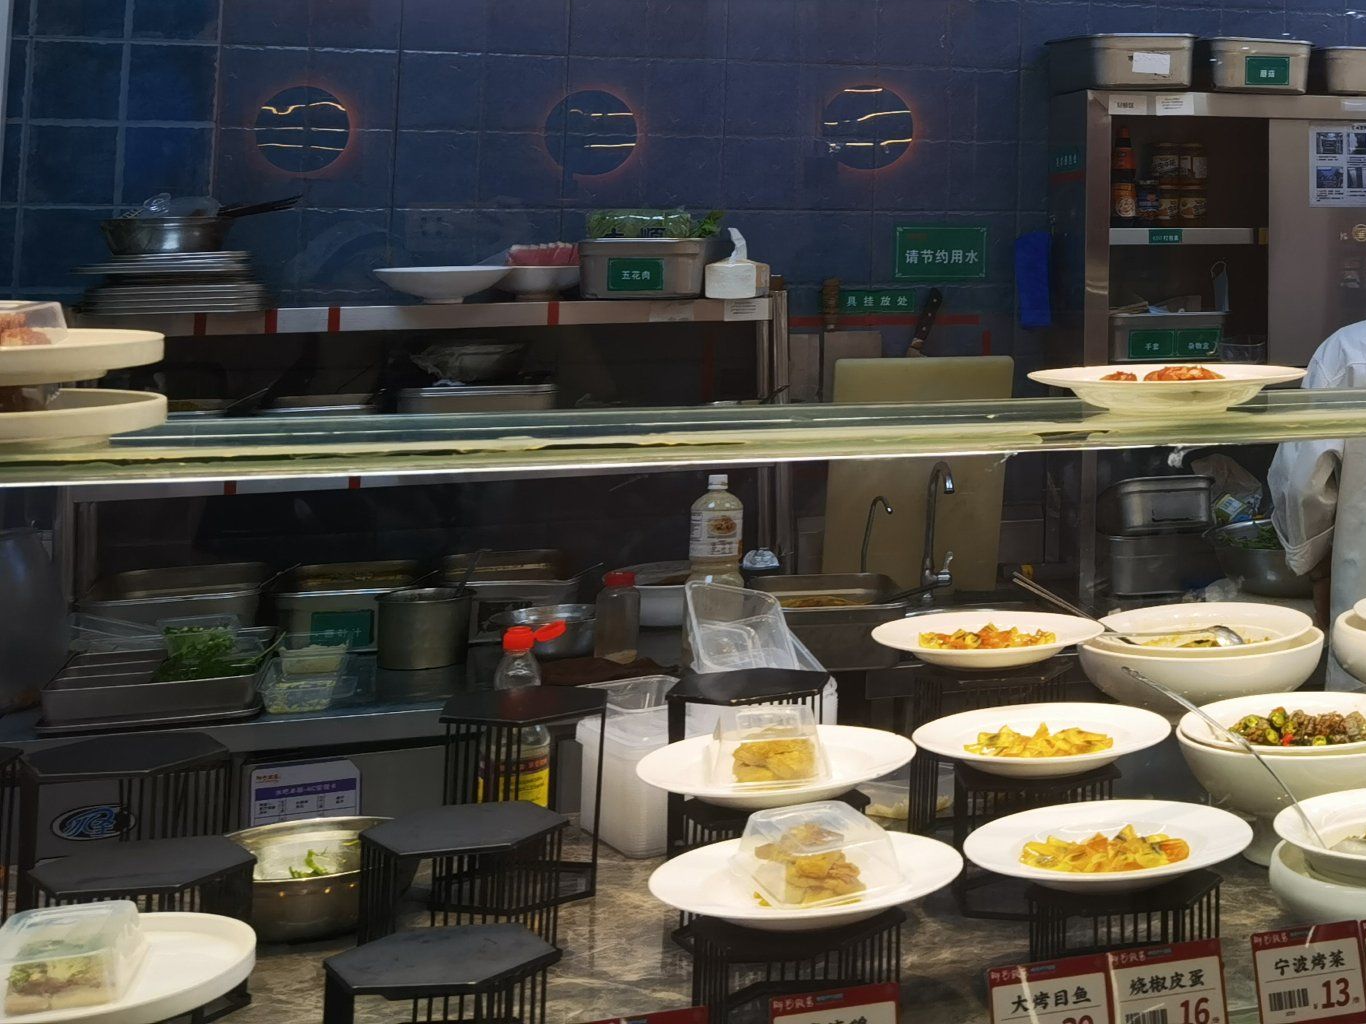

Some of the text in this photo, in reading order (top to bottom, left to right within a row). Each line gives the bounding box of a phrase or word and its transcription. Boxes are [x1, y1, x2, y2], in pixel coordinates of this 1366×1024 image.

[905, 249, 979, 264] 请节约用水
[621, 270, 651, 280] 五花肉
[1274, 949, 1346, 976] 宁波烤菜
[1129, 969, 1205, 996] 烧椒皮蛋
[1321, 977, 1350, 1009] 13
[1011, 985, 1092, 1015] 大烤目鱼
[1180, 997, 1210, 1024] 16
